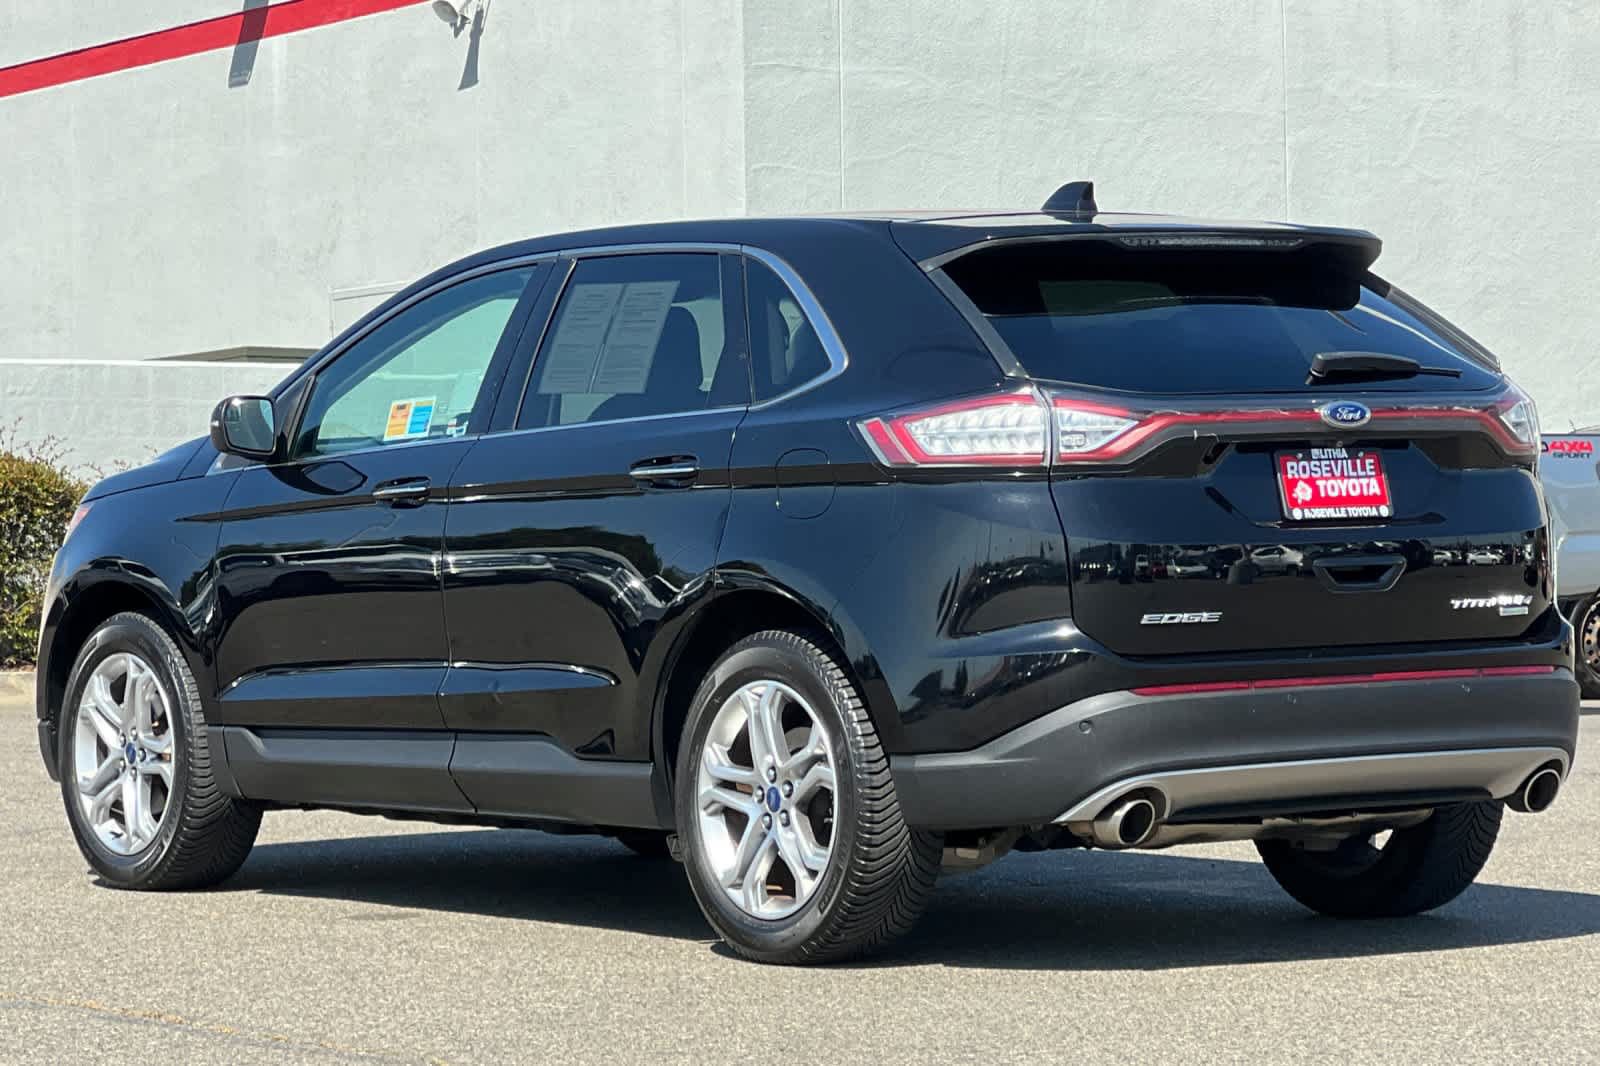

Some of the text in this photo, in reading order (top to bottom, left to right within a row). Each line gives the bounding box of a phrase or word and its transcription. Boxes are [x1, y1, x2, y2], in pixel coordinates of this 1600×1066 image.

[1336, 407, 1361, 420] Ford
[1319, 448, 1348, 459] LITHIA
[1286, 458, 1376, 479] ROSEVILLE
[1315, 478, 1381, 498] TOYOTA
[1303, 506, 1379, 519] ROSEVILLE TOYOTA
[1140, 611, 1223, 625] EDGE
